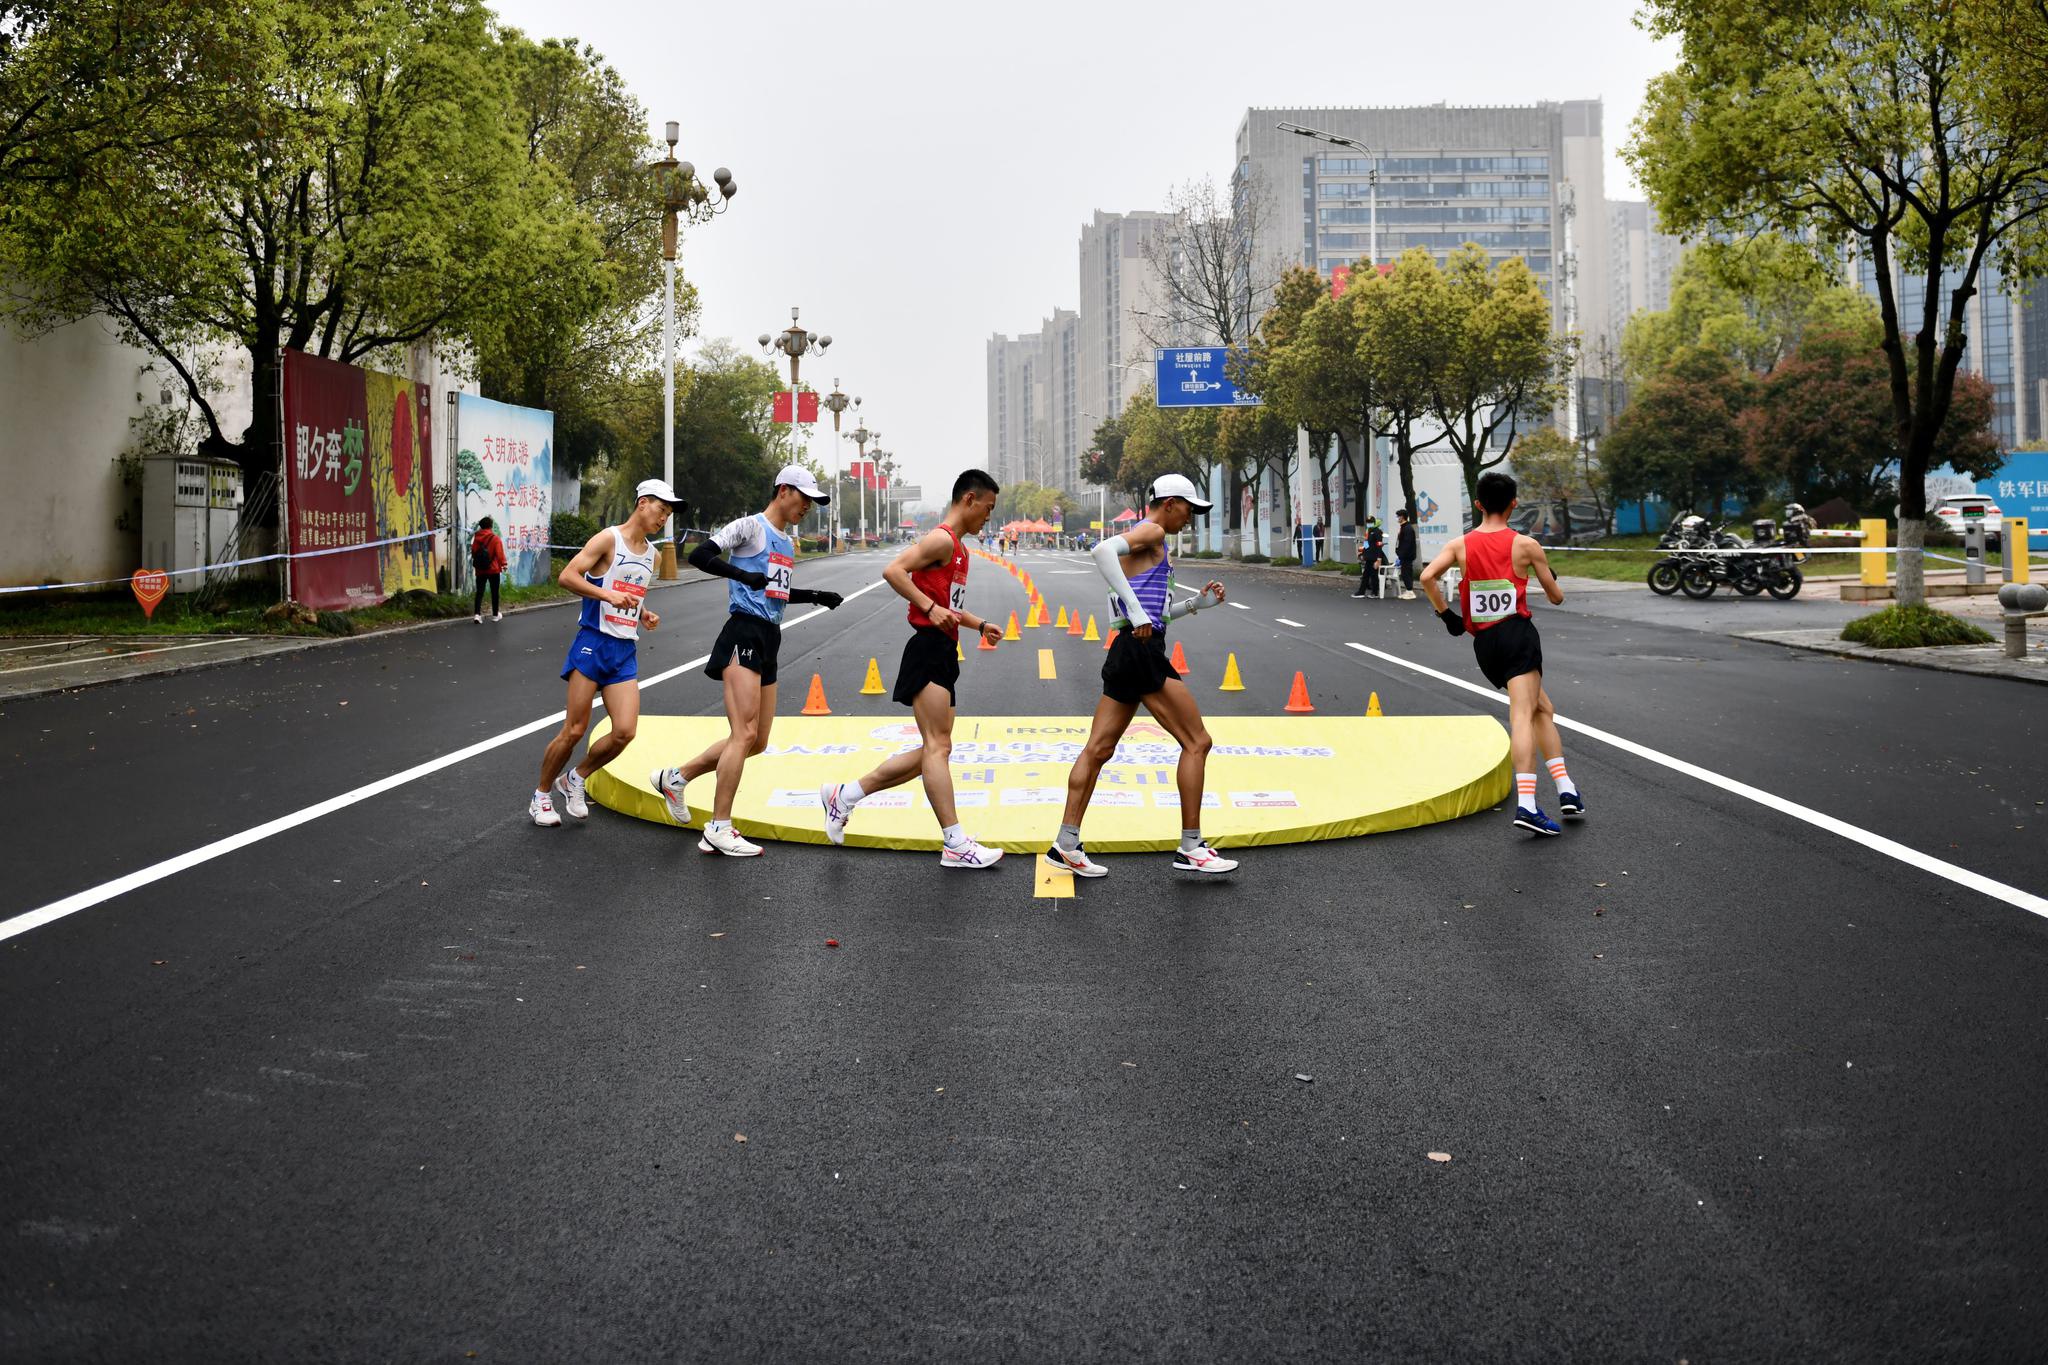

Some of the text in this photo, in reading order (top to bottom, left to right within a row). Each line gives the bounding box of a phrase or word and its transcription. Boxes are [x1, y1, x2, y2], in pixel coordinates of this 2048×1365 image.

[296, 418, 365, 496] 朝夕奔梦
[482, 435, 529, 466] 文明旅游
[495, 481, 539, 511] 安全旅游
[772, 567, 792, 589] 43
[1475, 592, 1512, 613] 309
